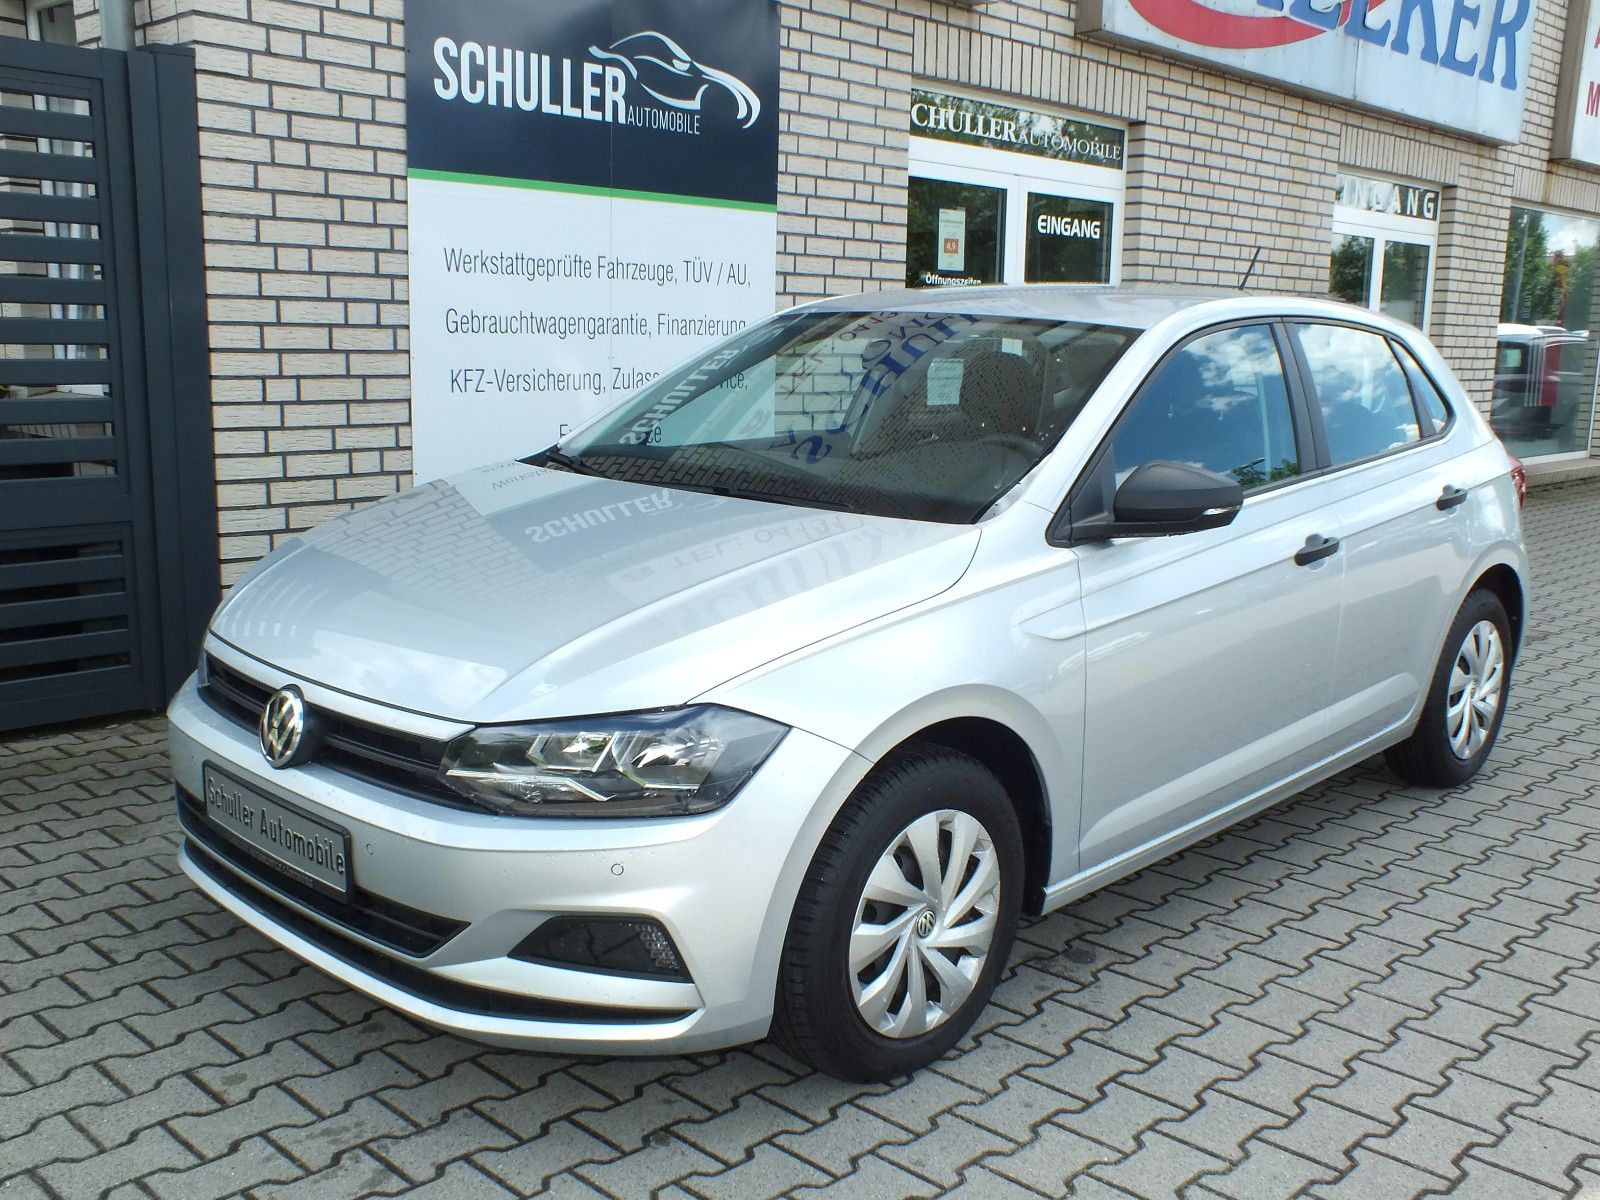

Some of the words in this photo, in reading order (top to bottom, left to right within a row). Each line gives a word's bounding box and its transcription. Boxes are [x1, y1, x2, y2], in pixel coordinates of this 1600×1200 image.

[433, 36, 627, 125] SCHULLER
[627, 105, 700, 136] AUTOMOBILE
[910, 103, 1017, 144] CHULLER
[1018, 132, 1122, 161] AUTOMOBILE
[1037, 214, 1101, 240] EINGANG
[444, 247, 592, 282] Werkstattgeprüfte
[597, 256, 678, 286] Fahrzeuge,
[683, 256, 713, 283] TÜV
[727, 263, 751, 288] AU,
[446, 308, 652, 340] Gebrauchtwagengarantie,
[450, 368, 606, 396] KFZ-Versicherung,
[207, 777, 255, 829] Schuller
[260, 807, 345, 875] Automobile
